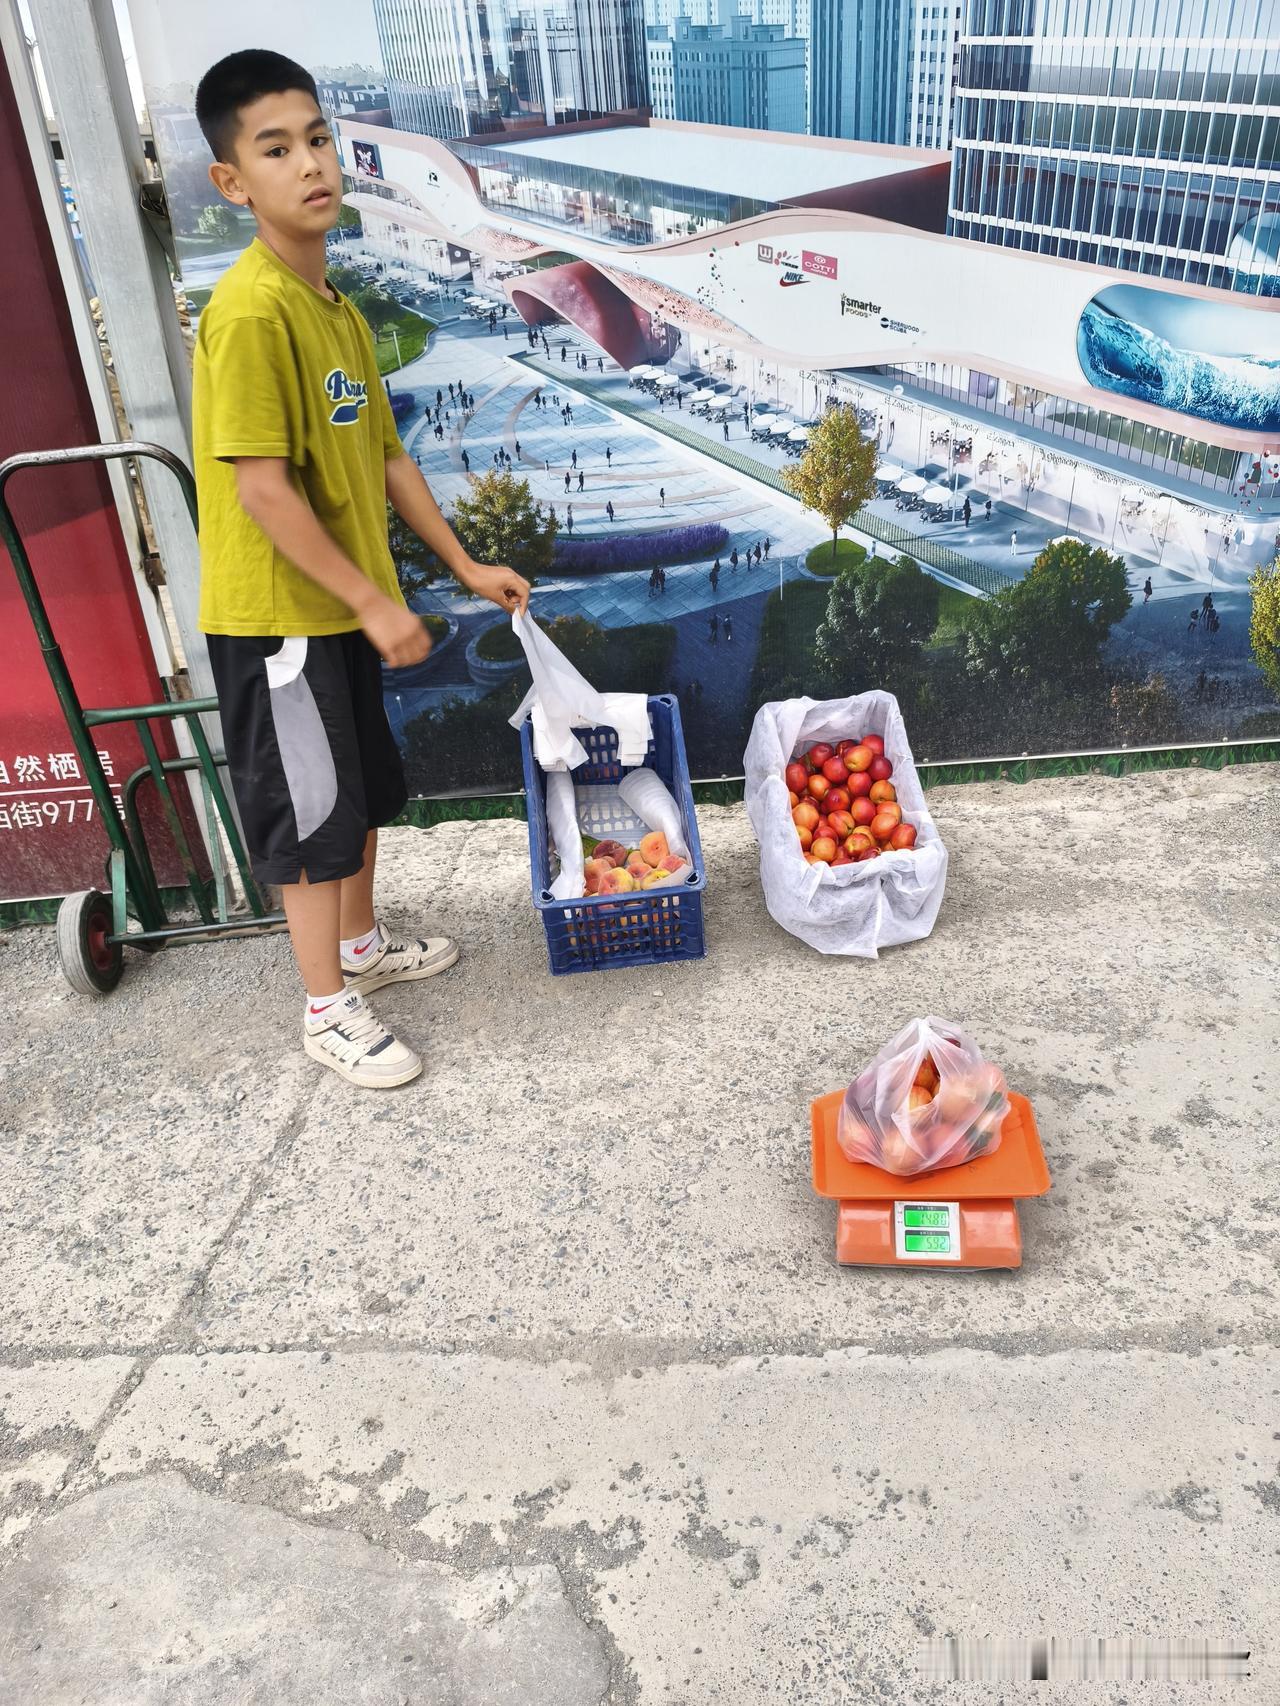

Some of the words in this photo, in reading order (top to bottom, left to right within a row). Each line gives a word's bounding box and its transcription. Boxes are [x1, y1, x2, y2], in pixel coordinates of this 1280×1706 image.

[804, 261, 835, 274] COTTI
[784, 271, 804, 282] NIKE
[846, 297, 882, 314] smarter
[845, 307, 868, 318] FOODS
[889, 324, 907, 334] SCUBA
[890, 319, 920, 333] SHERWOOD
